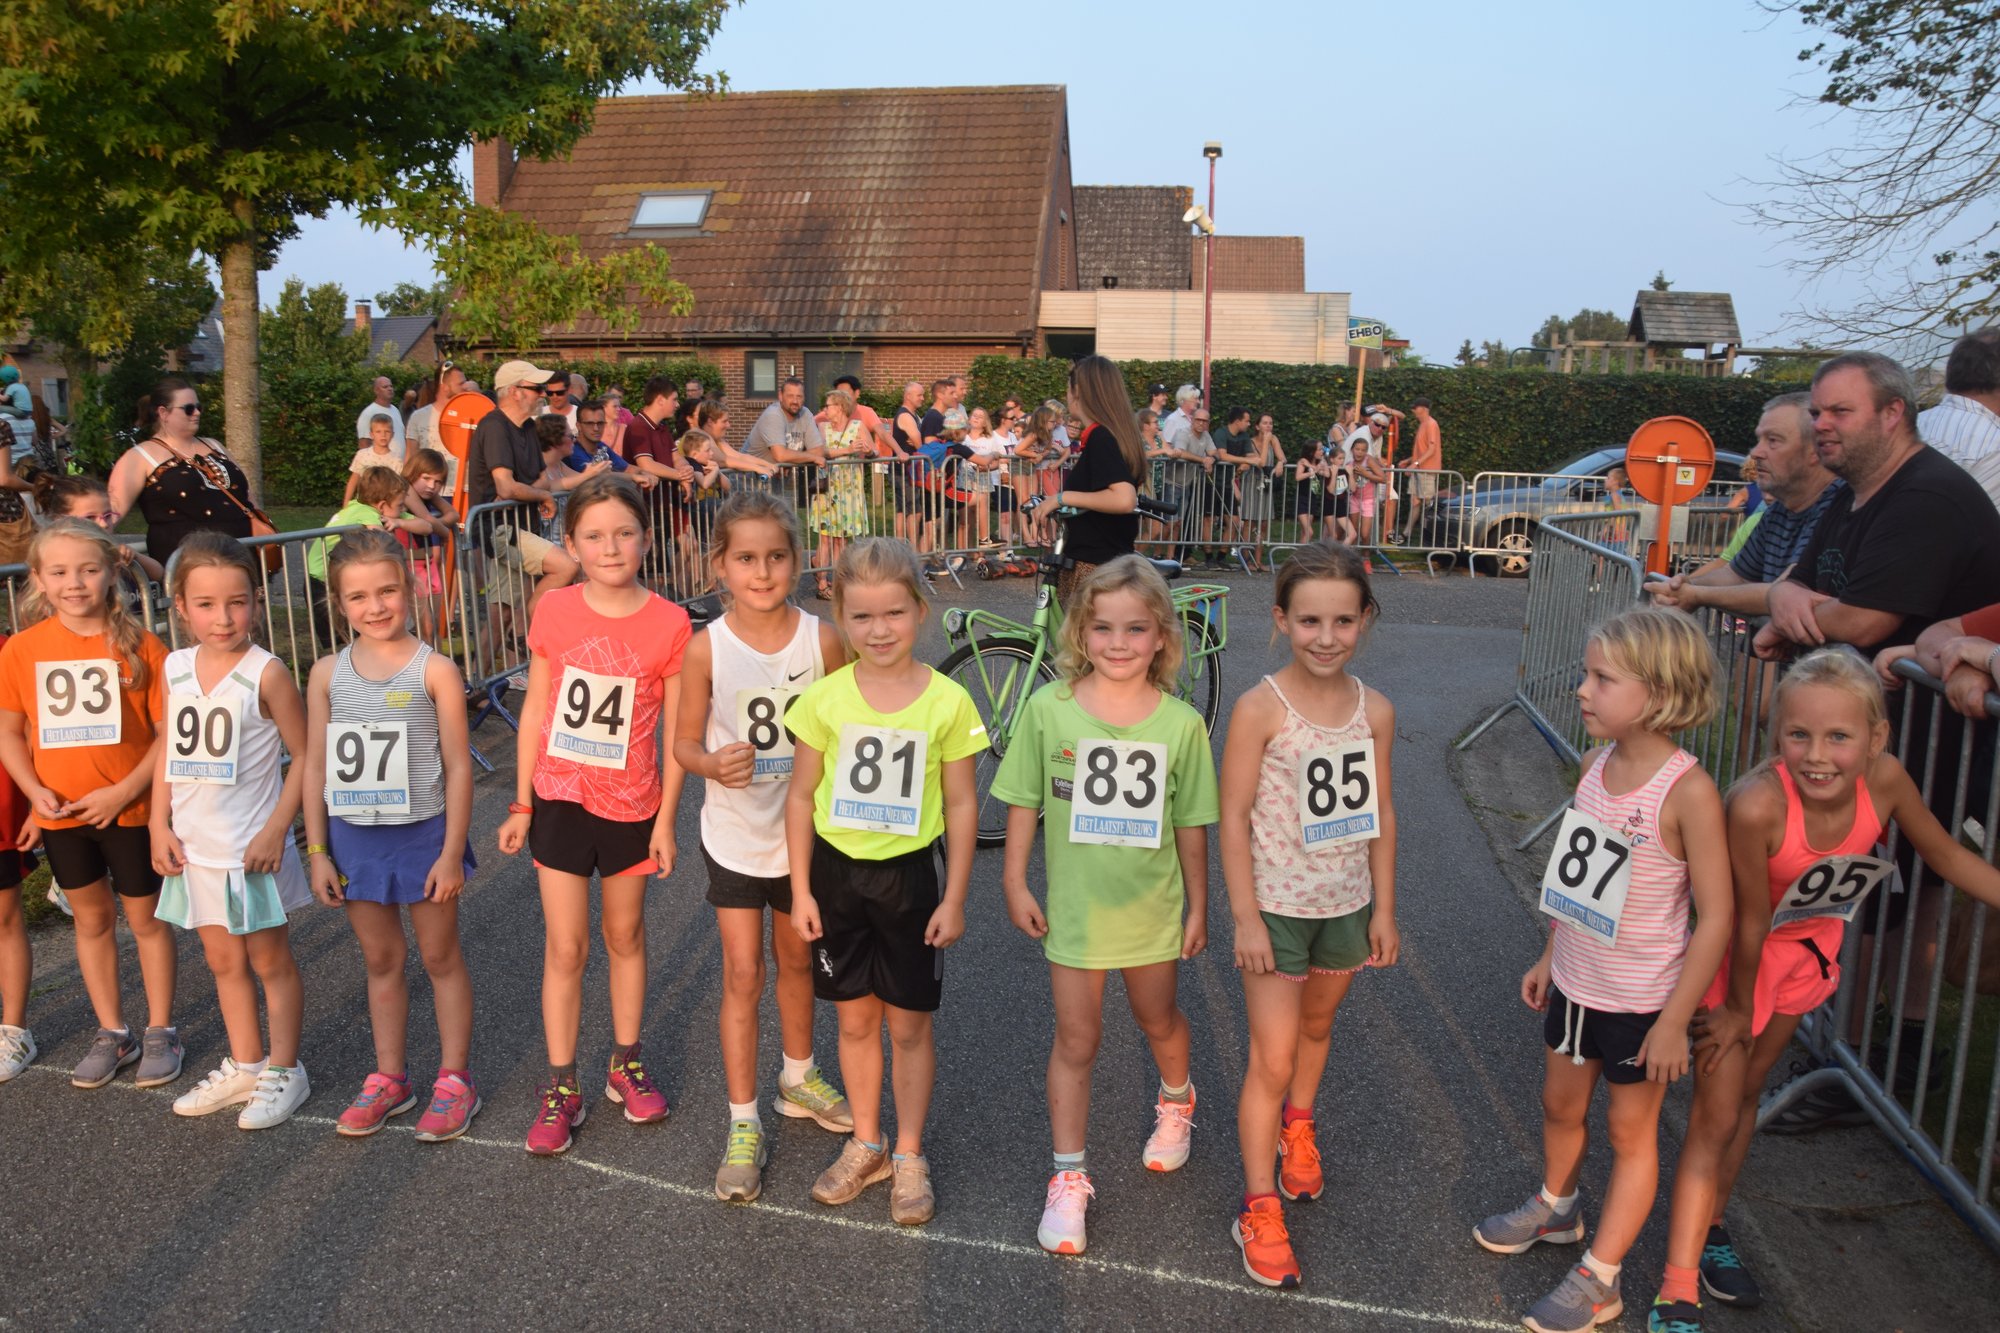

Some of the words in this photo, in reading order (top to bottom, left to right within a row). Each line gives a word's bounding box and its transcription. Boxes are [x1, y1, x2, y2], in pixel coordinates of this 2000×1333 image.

[1349, 325, 1382, 339] EHBO
[46, 667, 112, 716] 93
[564, 678, 624, 735] 94
[47, 729, 59, 742] HET
[60, 728, 87, 741] LAATSTE
[88, 726, 114, 740] NIEUWS
[176, 706, 233, 757] 90
[748, 694, 801, 750] 8
[336, 731, 400, 783] 97
[557, 734, 570, 748] HET
[570, 737, 596, 755] LAATSTE
[596, 743, 620, 758] NIEUWS
[764, 759, 793, 773] LAATSTE
[850, 736, 916, 798] 81
[173, 762, 184, 774] HET
[184, 763, 207, 776] LAATSTE
[208, 764, 231, 777] NIEUWS
[1084, 747, 1156, 808] 83
[1307, 751, 1370, 817] 85
[336, 792, 349, 804] HET
[349, 791, 377, 804] LAATSTE
[377, 790, 403, 803] NIEUWS
[838, 800, 853, 816] HET
[854, 803, 885, 821] LAATSTE
[885, 806, 913, 824] NIEUWS
[1078, 816, 1093, 832] HET
[1094, 817, 1125, 835] LAATSTE
[1125, 820, 1153, 837] NIEUWS
[1307, 826, 1320, 841] HET
[1320, 821, 1348, 838] LAATSTE
[1347, 816, 1371, 835] NIEUWS
[1558, 827, 1628, 901] 87
[1790, 862, 1880, 907] 95
[1549, 890, 1560, 907] HET
[1560, 896, 1585, 920] LAATSTE
[1585, 908, 1612, 934] NIEUWS
